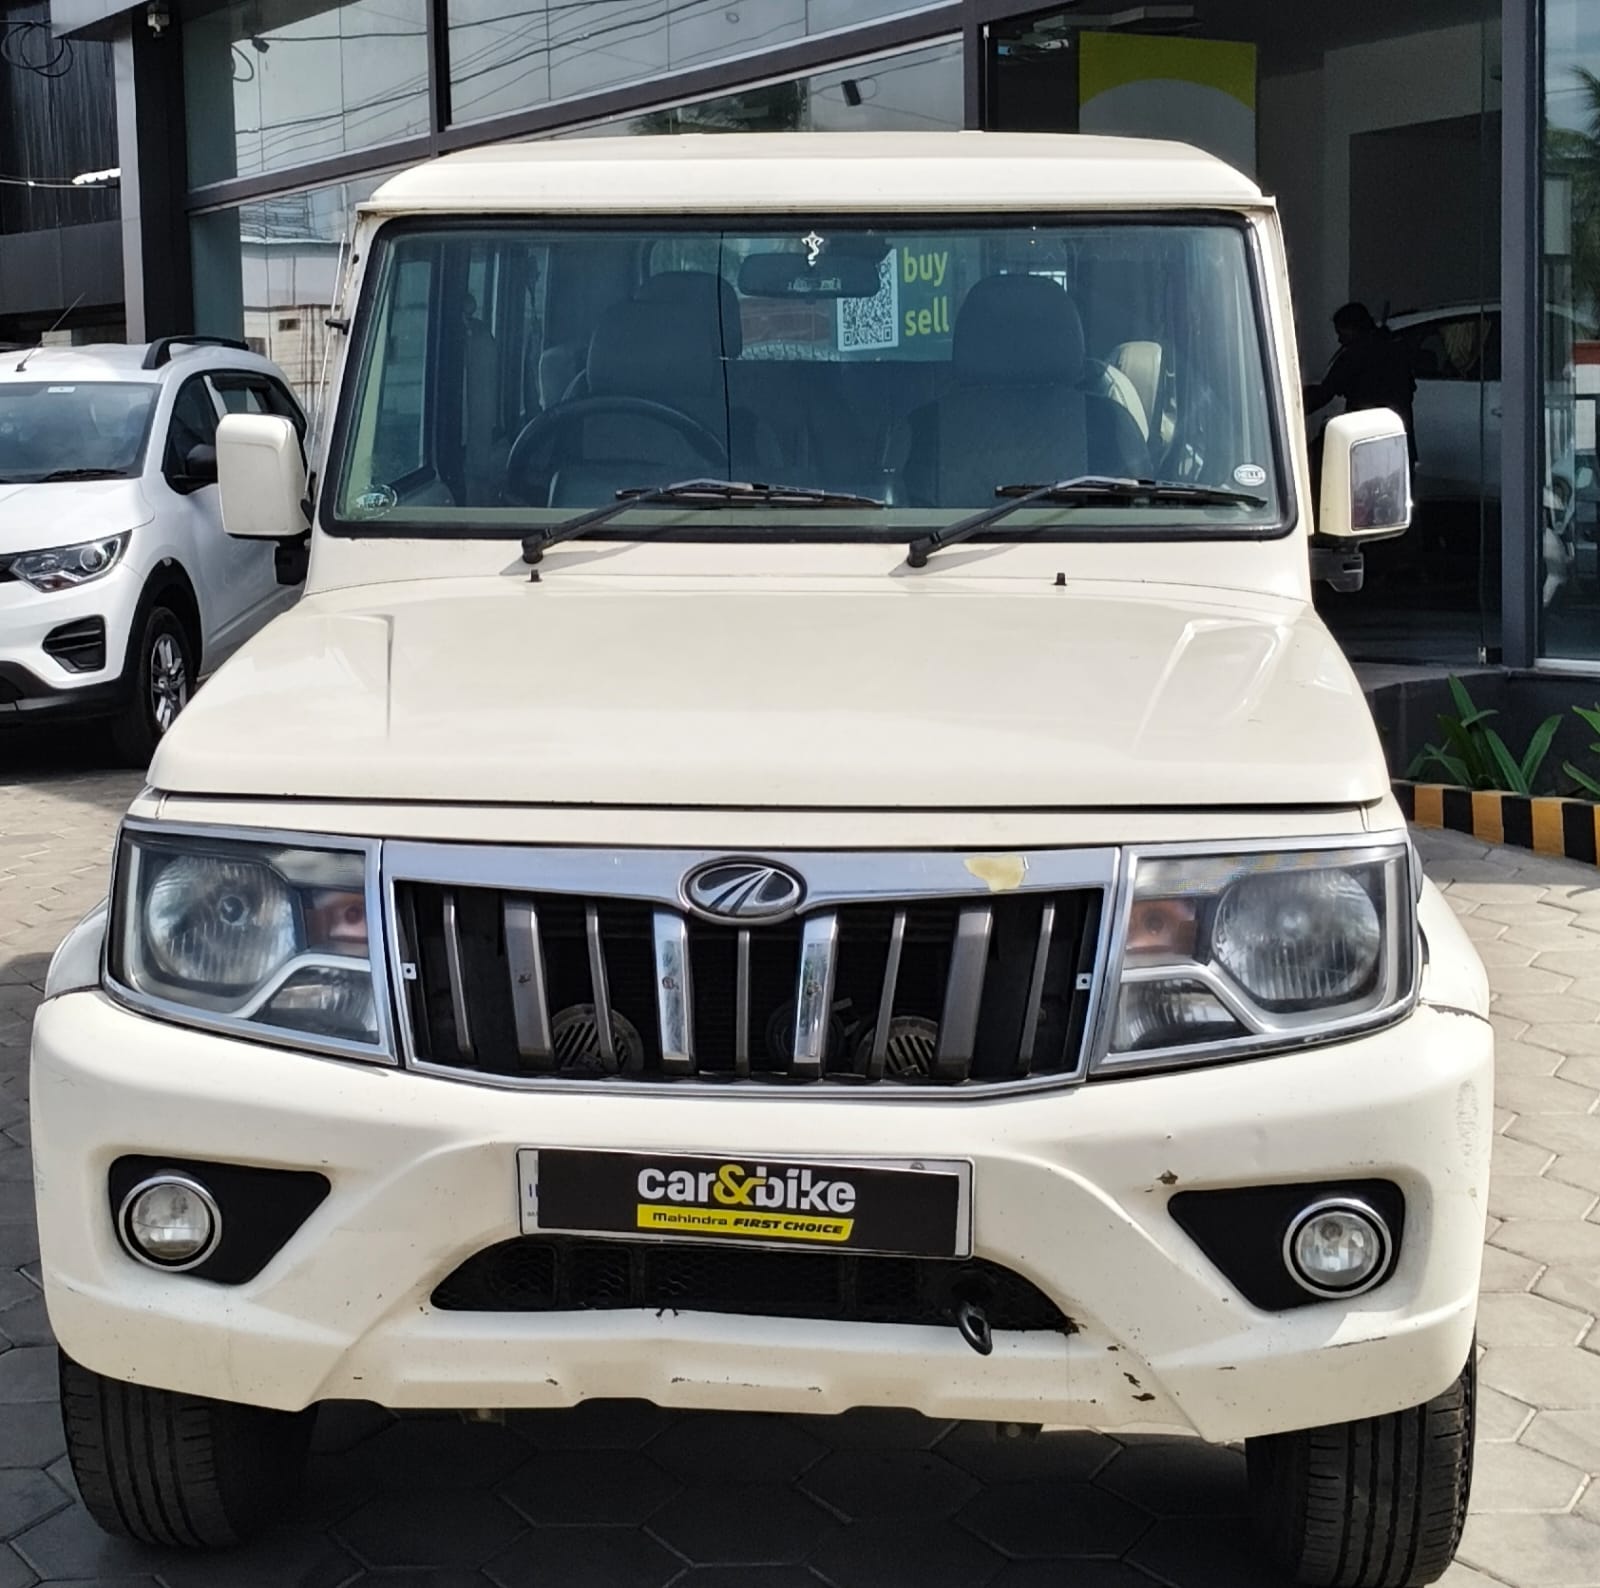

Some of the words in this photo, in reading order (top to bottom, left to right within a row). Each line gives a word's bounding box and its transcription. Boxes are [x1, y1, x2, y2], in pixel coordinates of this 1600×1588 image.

[903, 247, 948, 287] buy
[905, 296, 949, 337] sell
[637, 1164, 856, 1213] car&bike
[652, 1212, 728, 1226] Mahindra
[733, 1217, 782, 1229] FIRST
[783, 1221, 844, 1235] CHOICE
